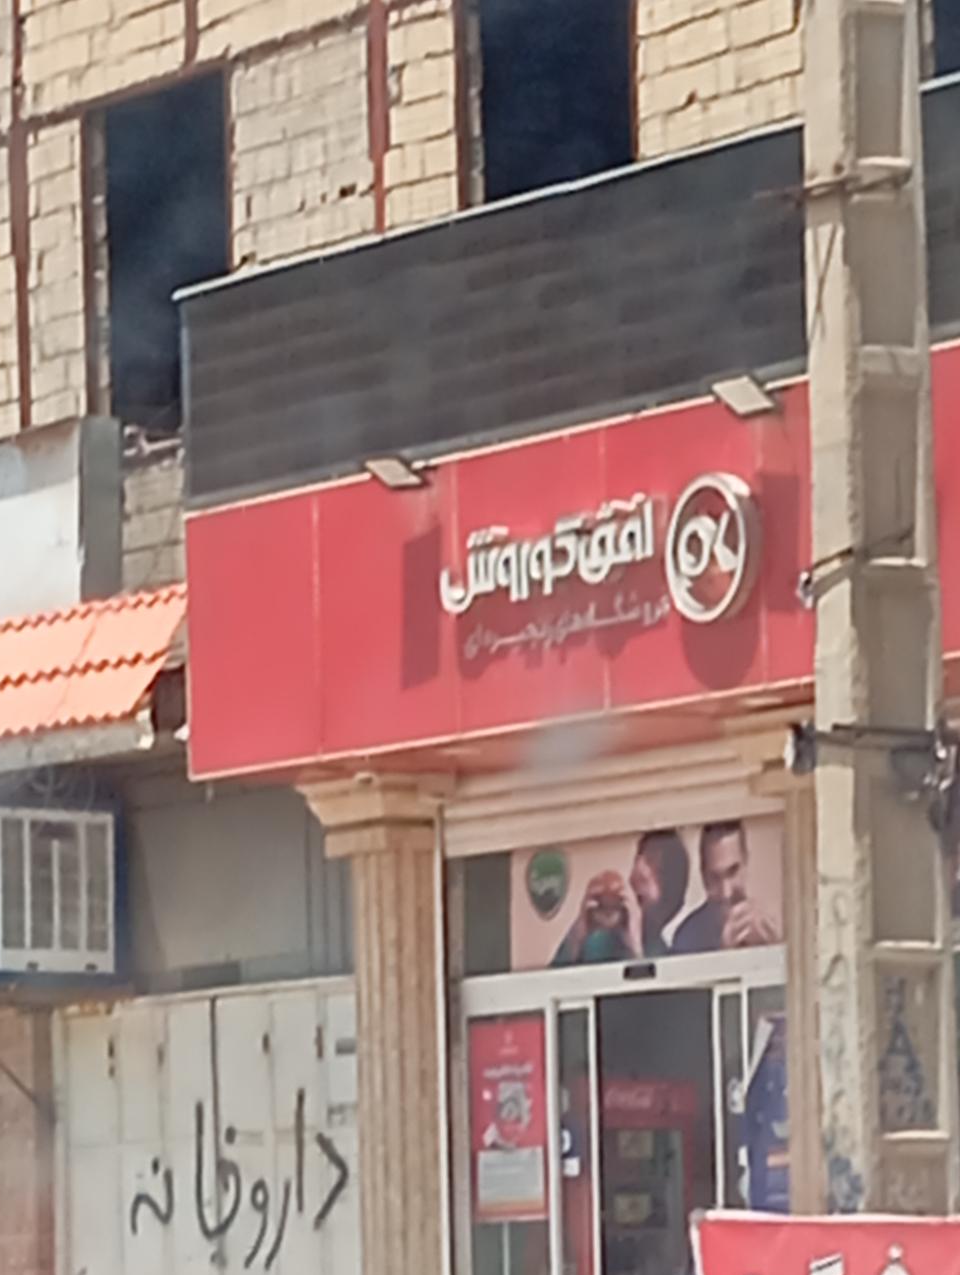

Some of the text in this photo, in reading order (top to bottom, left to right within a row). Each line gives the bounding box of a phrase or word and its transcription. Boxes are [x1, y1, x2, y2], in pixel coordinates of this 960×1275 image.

[440, 492, 654, 614] افق کوروش
[130, 1087, 349, 1270] داروخانه
